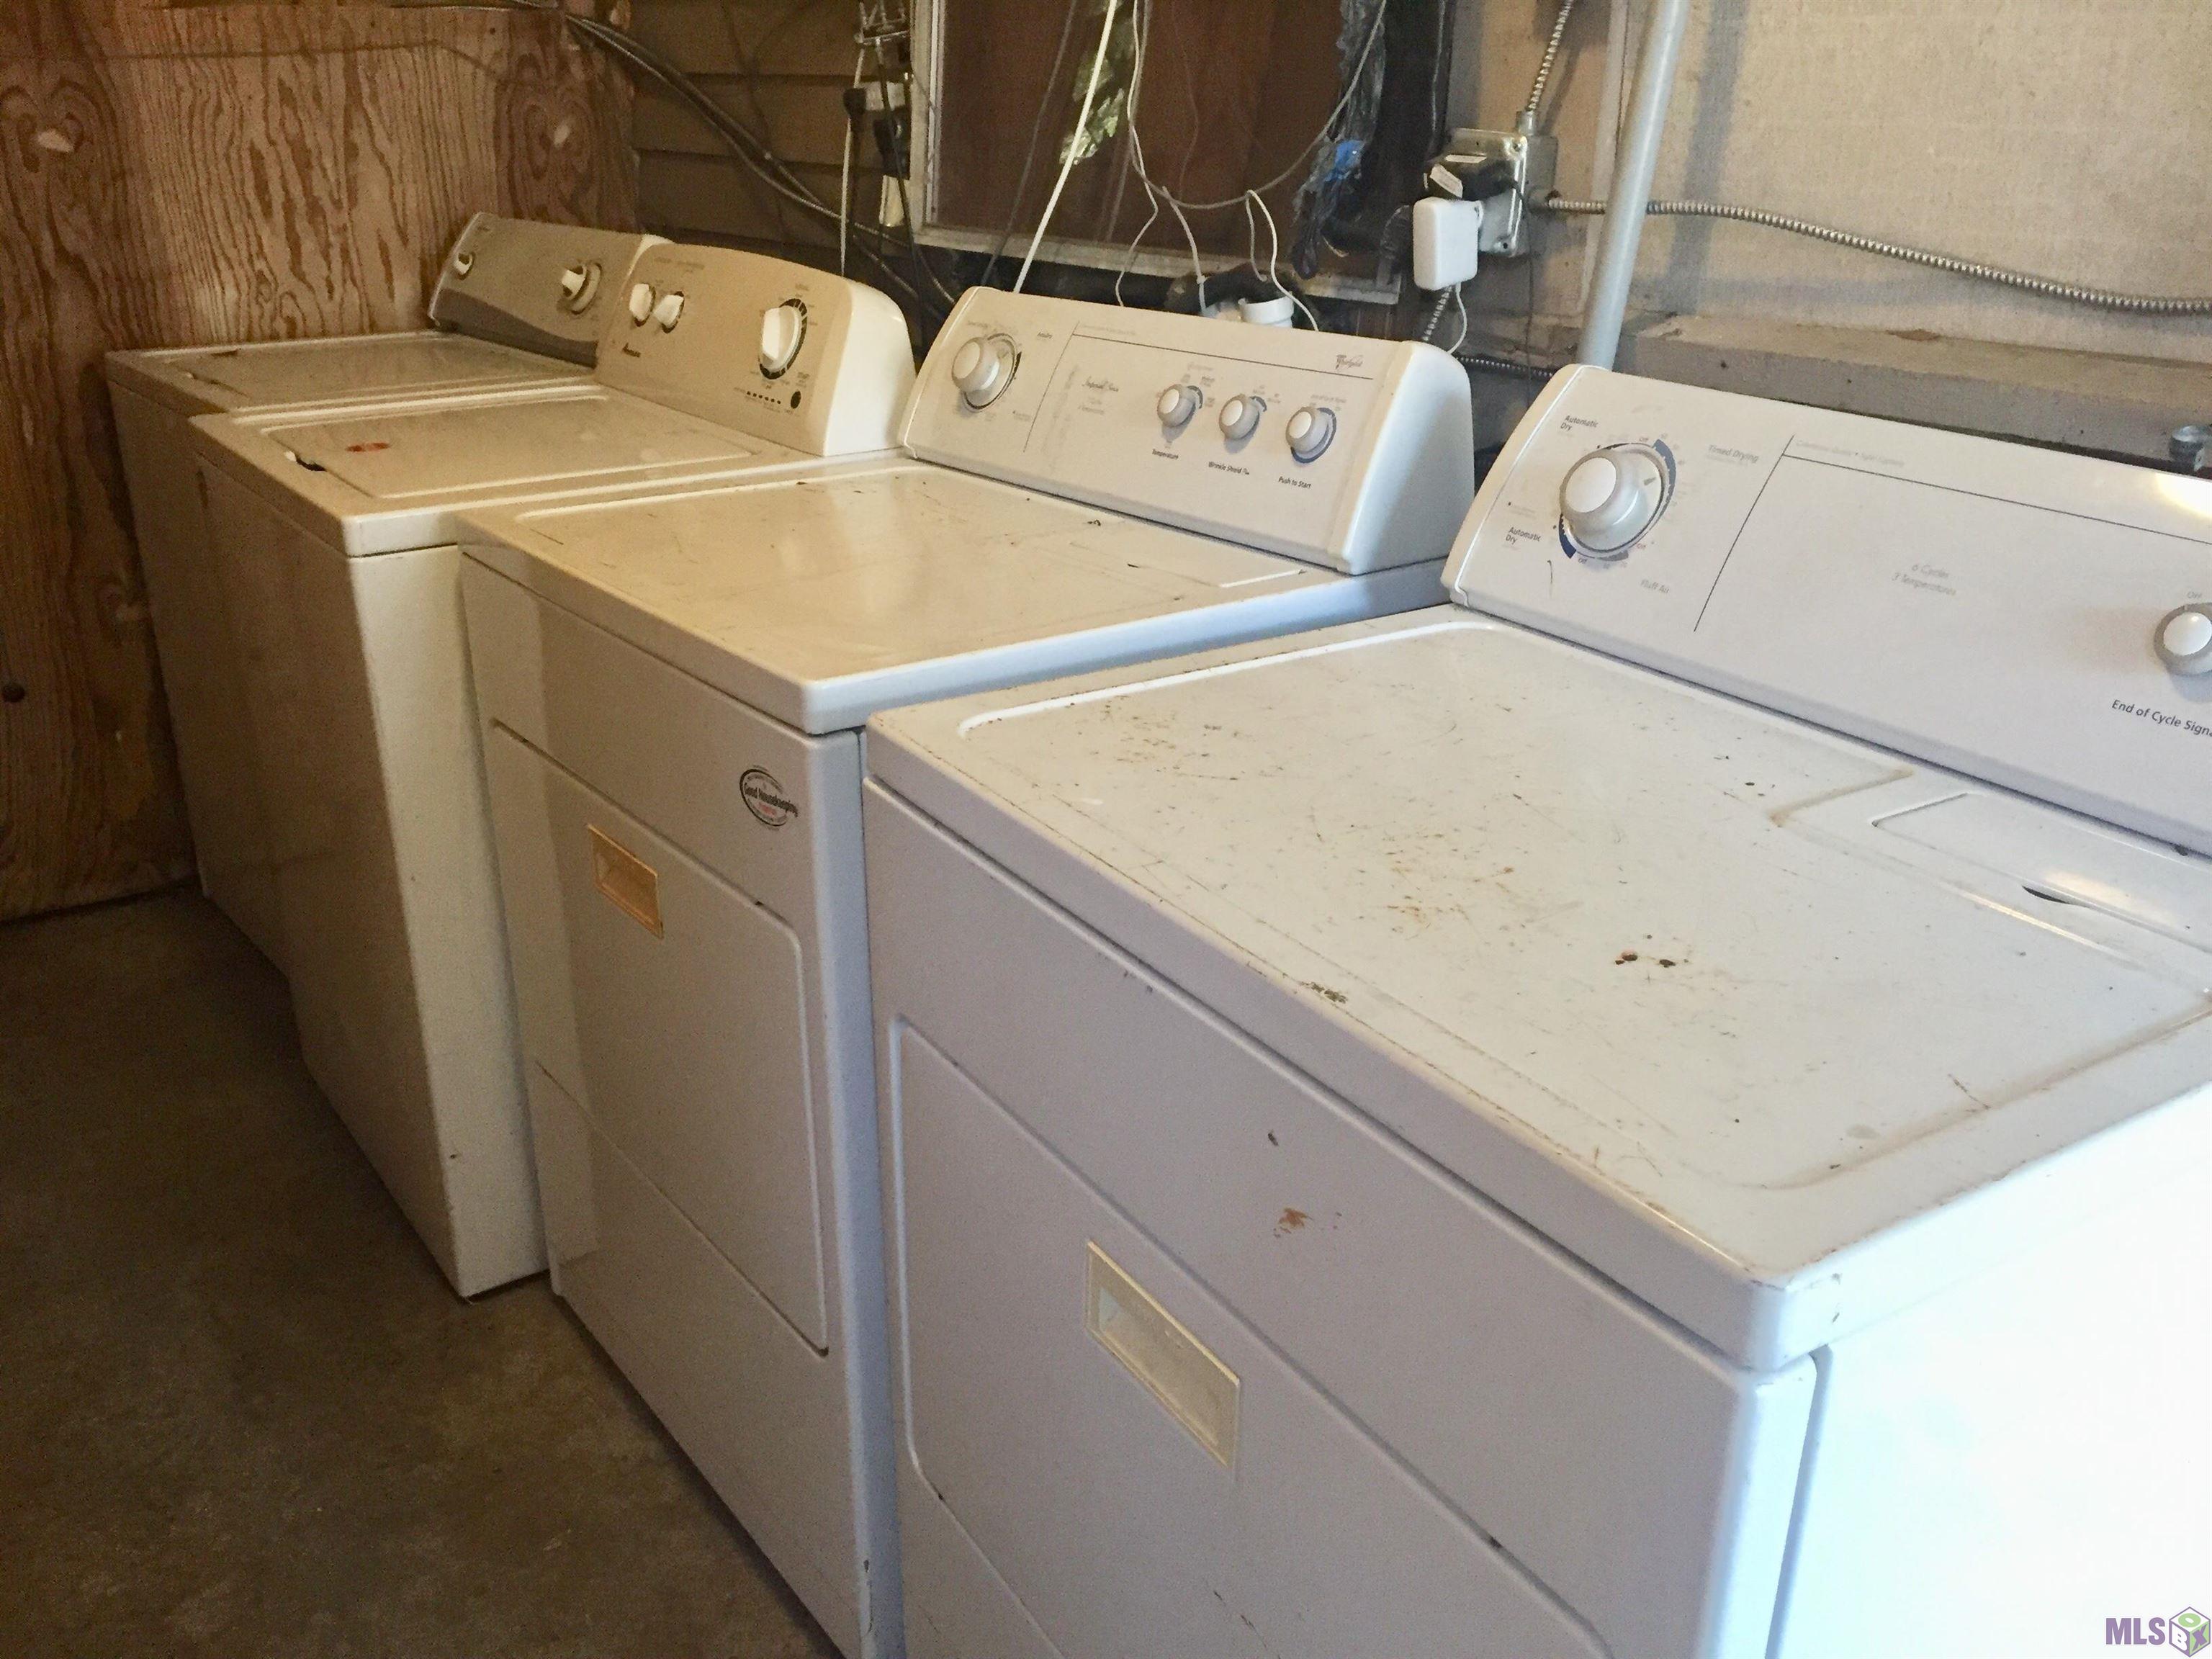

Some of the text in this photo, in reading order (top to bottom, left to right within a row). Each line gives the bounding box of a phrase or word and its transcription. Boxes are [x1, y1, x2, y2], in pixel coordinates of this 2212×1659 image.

[1560, 423, 1573, 432] Dry
[1564, 415, 1599, 428] Automatic
[1708, 444, 1731, 457] Timed
[1732, 449, 1759, 464] Drying
[1278, 476, 1291, 485] Push
[1506, 534, 1518, 546] Dry
[1509, 527, 1542, 542] Automatic
[2111, 699, 2135, 714] End
[2136, 708, 2151, 717] of
[2152, 711, 2182, 727] Cycle
